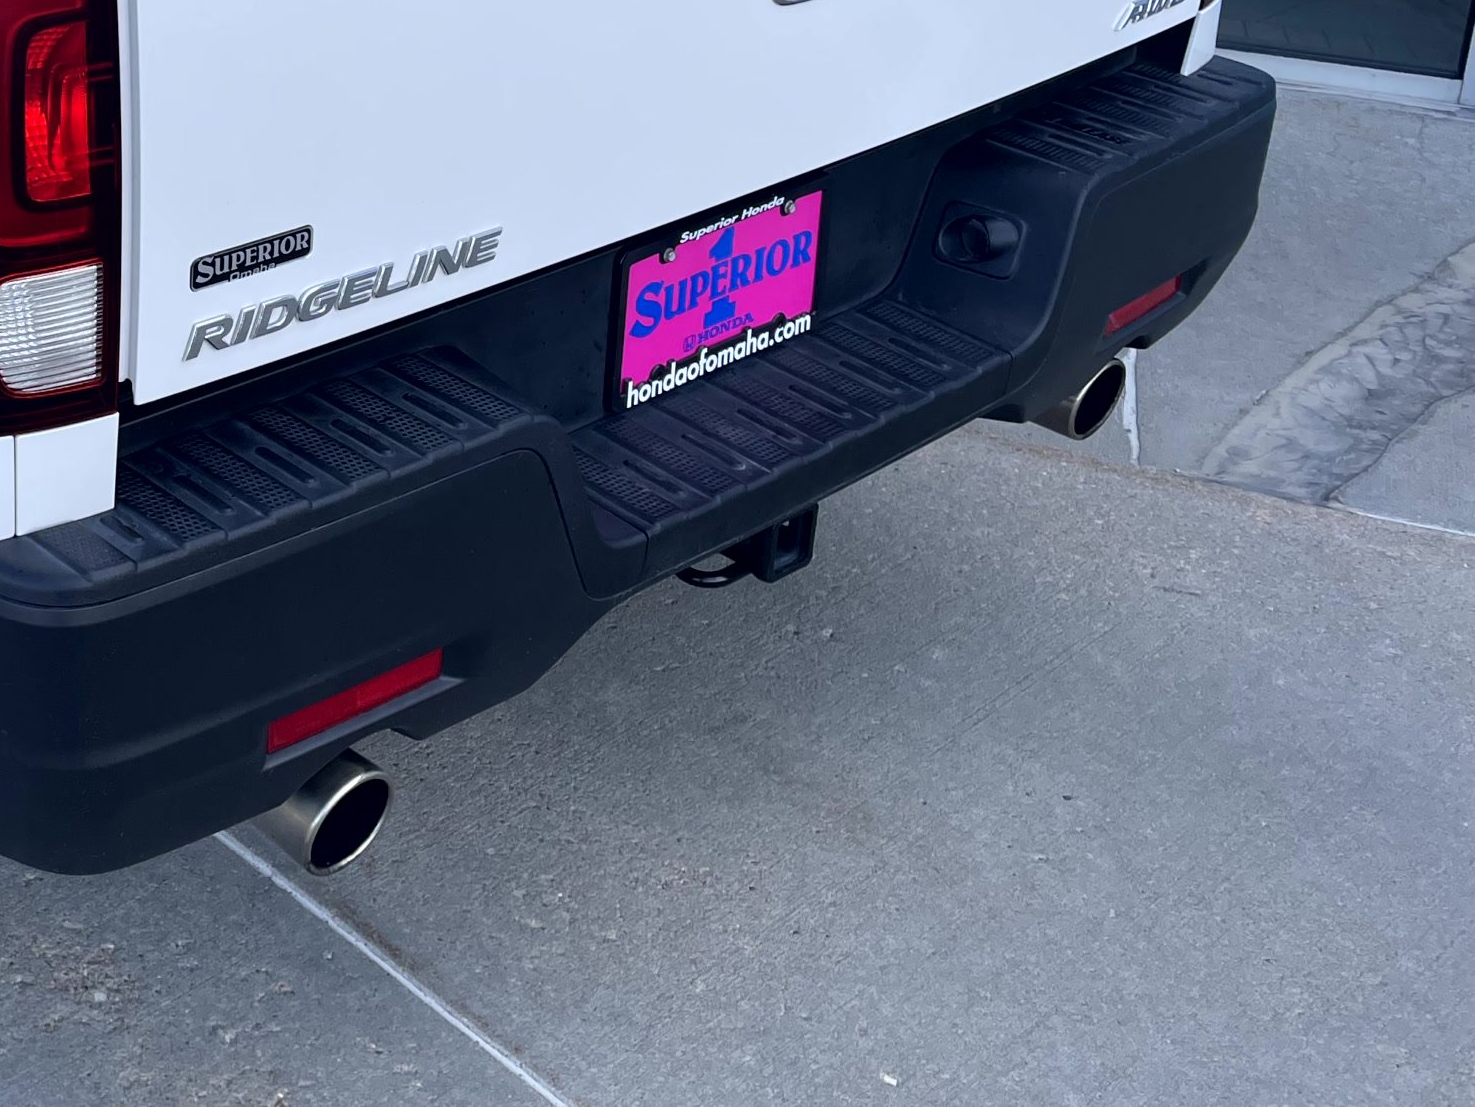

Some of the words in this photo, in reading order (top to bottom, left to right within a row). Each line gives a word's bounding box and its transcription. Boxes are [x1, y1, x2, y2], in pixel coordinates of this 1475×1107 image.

[679, 214, 739, 244] Superior
[740, 196, 785, 221] Honda
[195, 231, 309, 284] SUPERIOR
[229, 262, 277, 282] Omaha
[181, 226, 504, 362] RIDGELINE
[697, 312, 754, 344] HONDA
[626, 313, 812, 409] hondaofomaha.com
